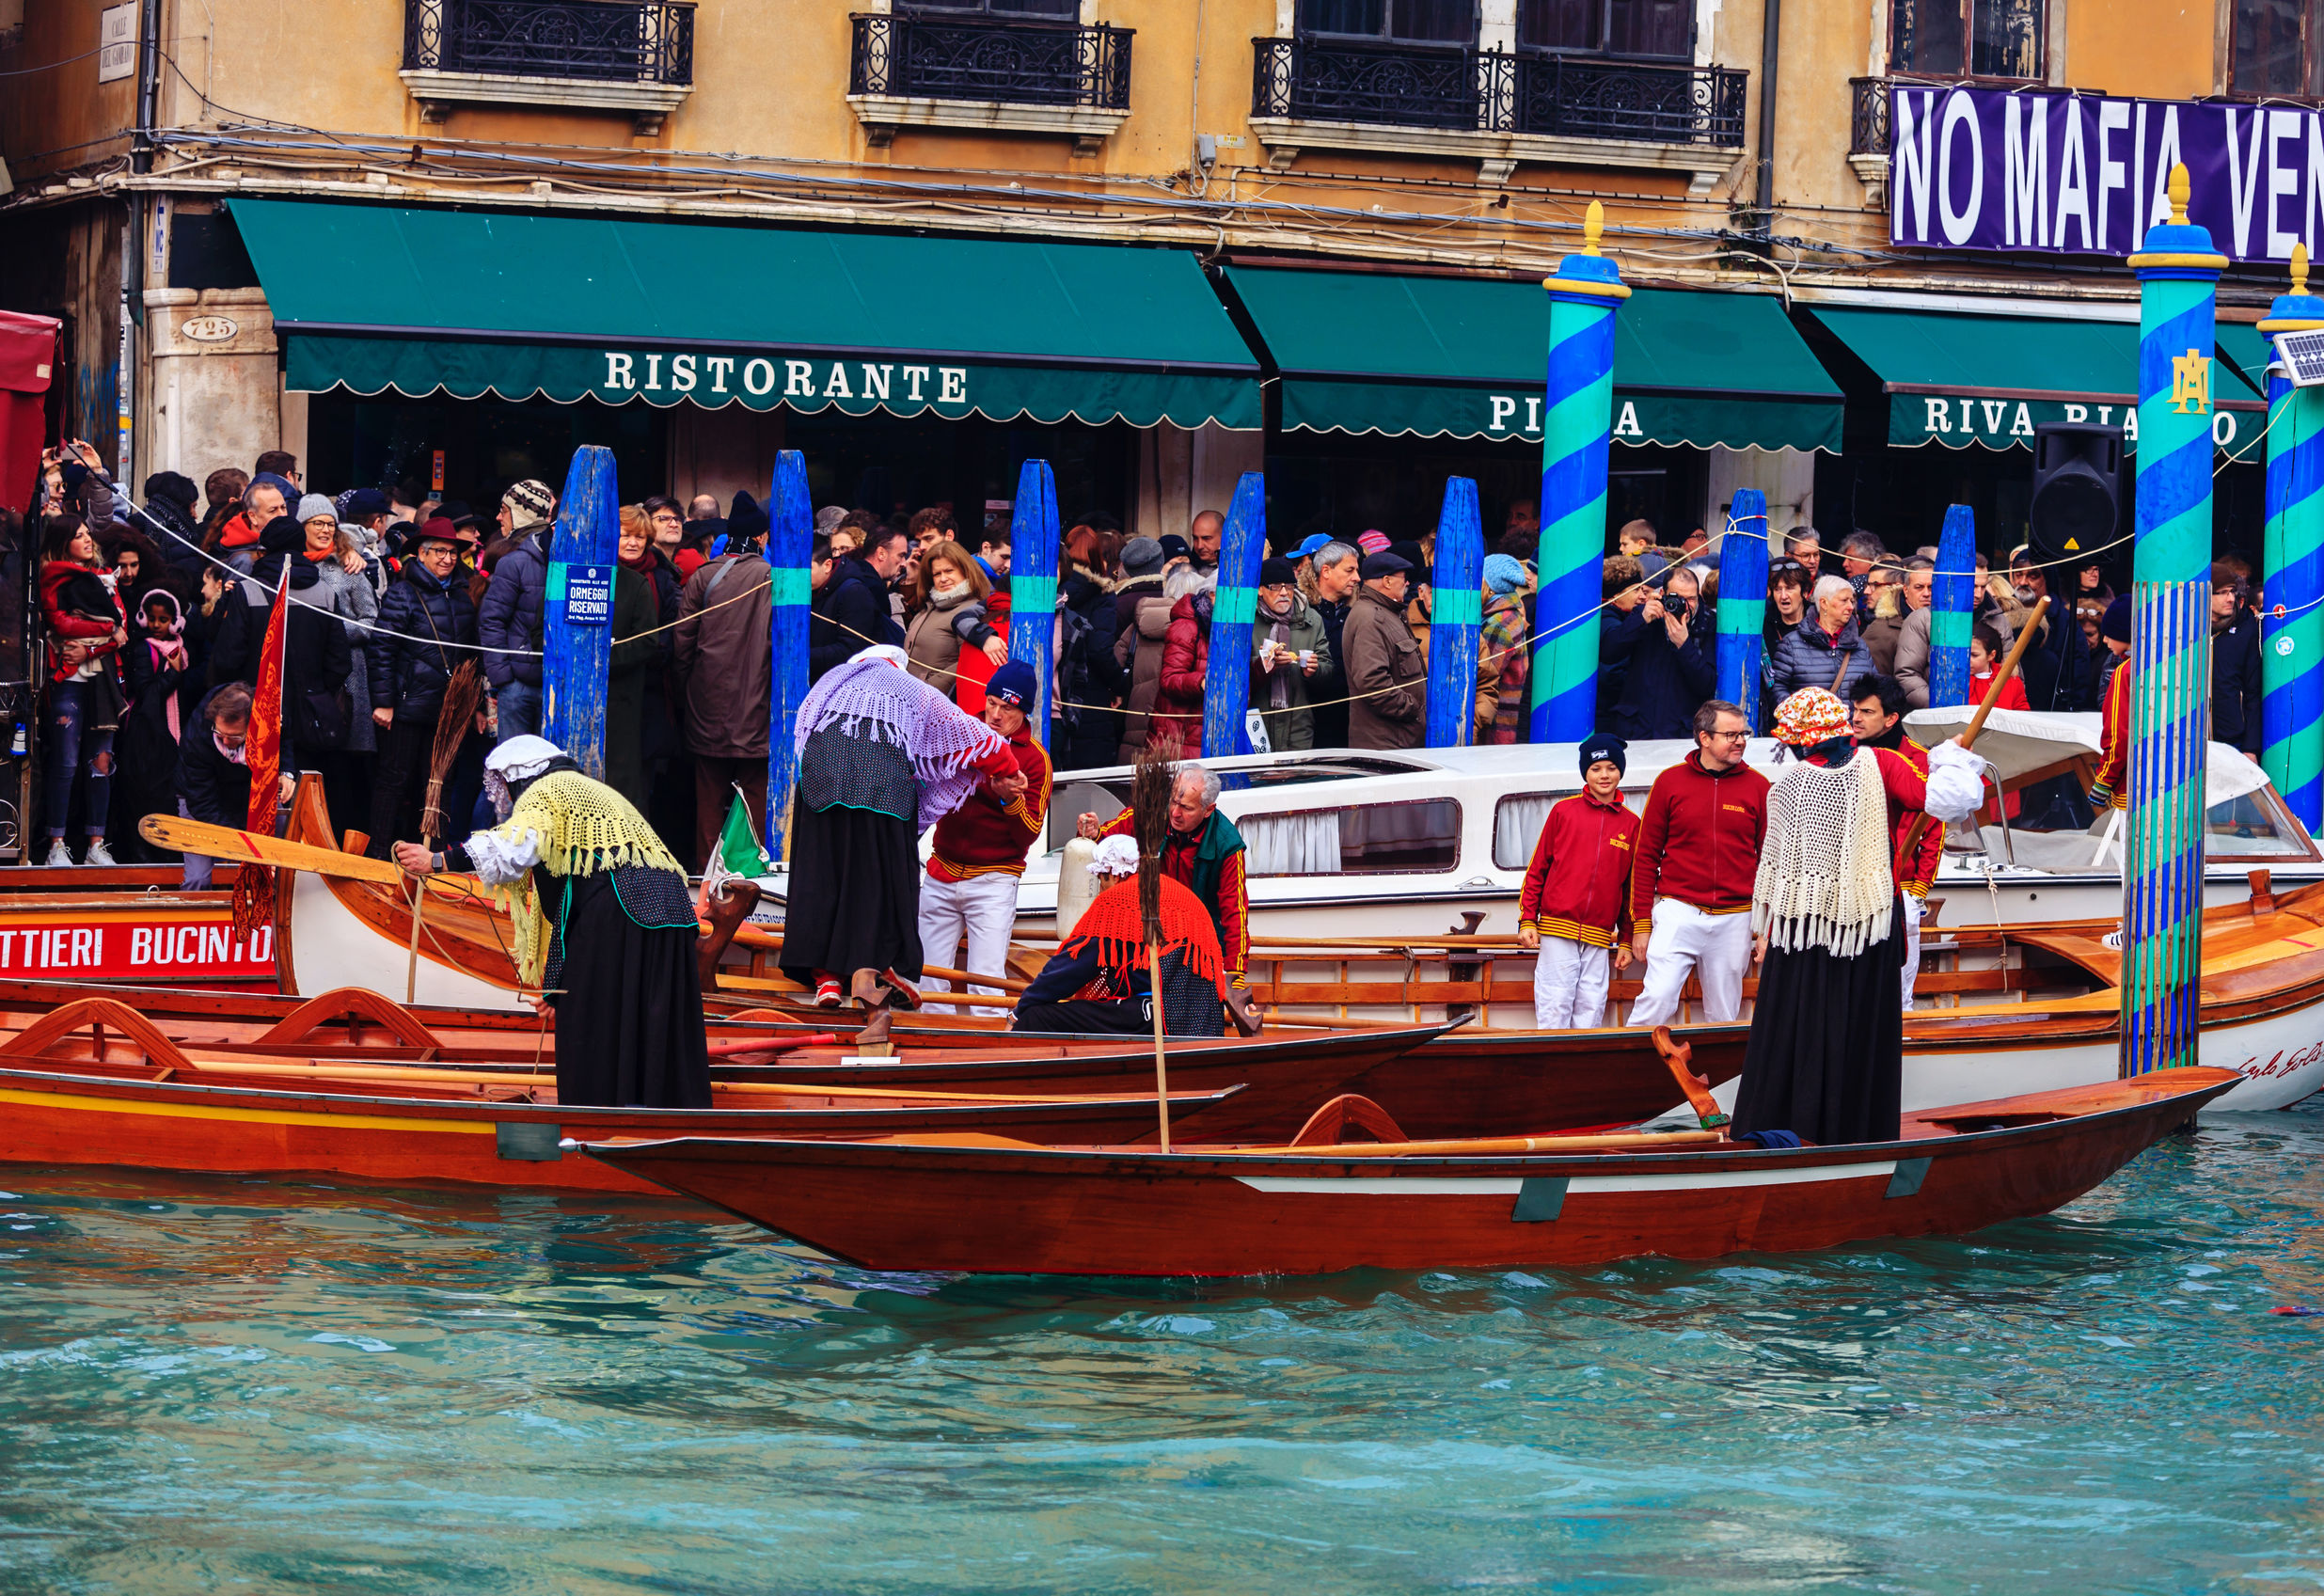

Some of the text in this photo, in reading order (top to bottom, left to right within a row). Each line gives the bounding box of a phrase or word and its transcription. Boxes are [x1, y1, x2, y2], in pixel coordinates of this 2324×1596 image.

[111, 16, 127, 38] CALLE
[1894, 90, 1983, 245] NO
[2004, 95, 2190, 251] MAFIA
[191, 321, 230, 336] 725
[604, 353, 966, 403] RISTORANTE
[1489, 396, 1643, 435] PIA
[1924, 398, 2237, 446] RIVA RIAO
[569, 600, 608, 614] RISERVATO
[570, 587, 608, 600] ORMEGGIO
[0, 925, 275, 968] TTIERI BUCINTO
